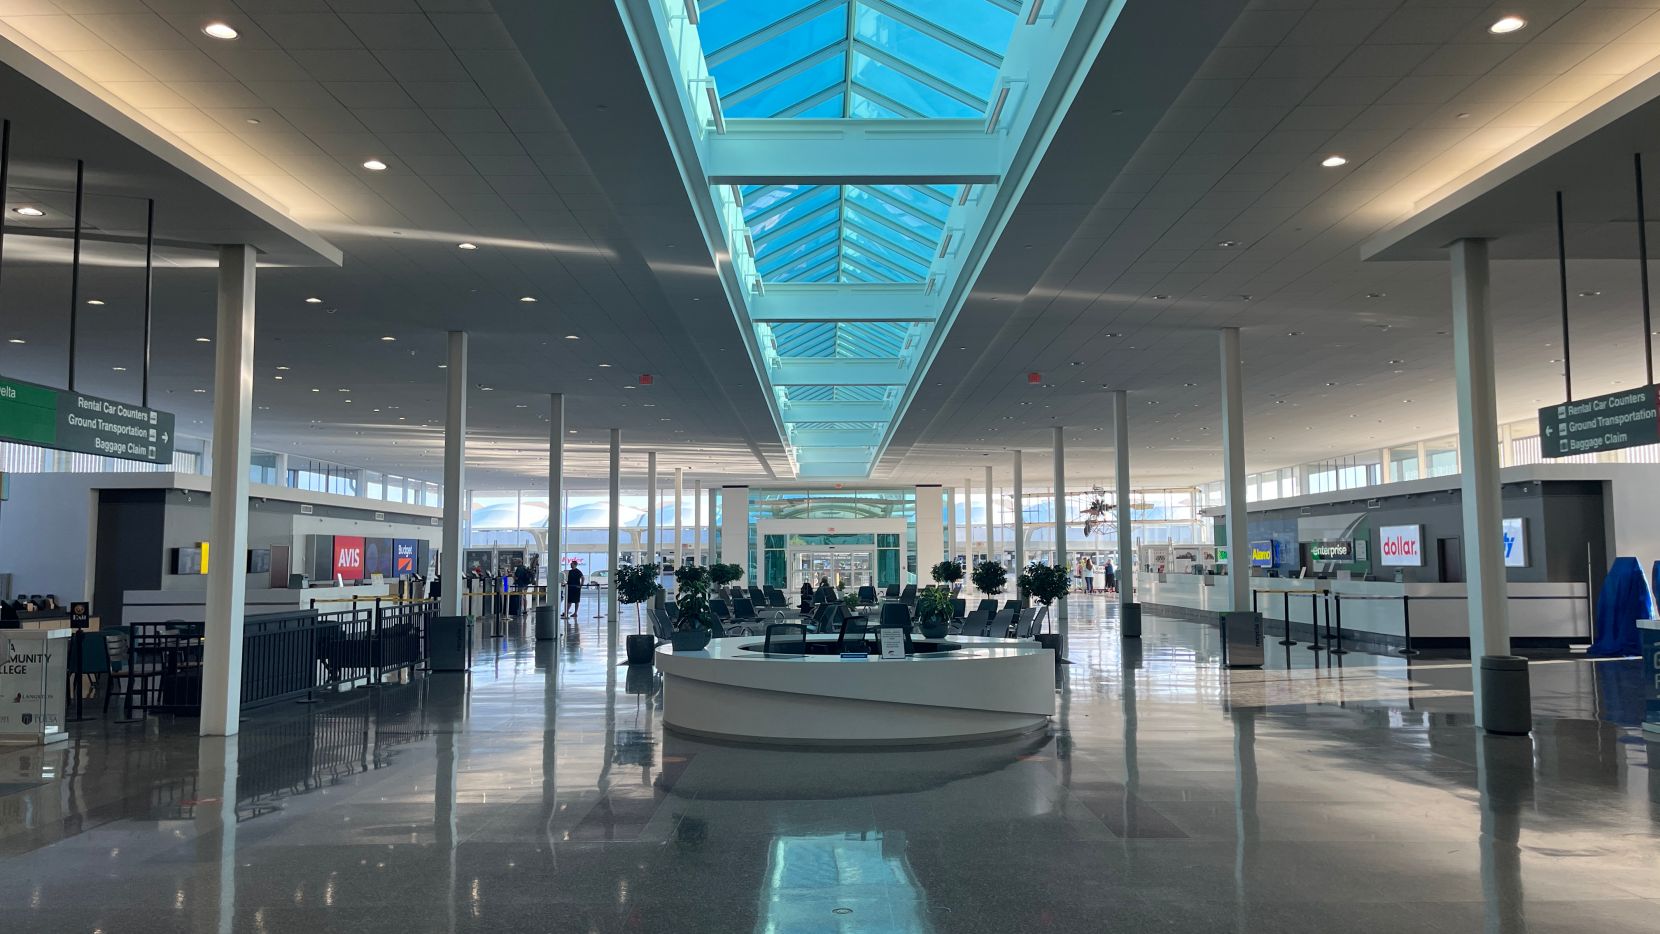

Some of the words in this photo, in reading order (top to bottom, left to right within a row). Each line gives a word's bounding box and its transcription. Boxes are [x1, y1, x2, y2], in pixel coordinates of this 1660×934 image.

[0, 385, 16, 399] elta
[78, 396, 102, 412] Rental
[103, 402, 116, 413] Car
[117, 405, 148, 421] Counters
[1568, 402, 1592, 415] Rental
[1593, 400, 1607, 410] Car
[1608, 393, 1646, 407] Counters
[68, 414, 97, 429] Ground
[98, 419, 148, 438] Transportation
[1569, 418, 1597, 432] Ground
[1597, 409, 1657, 426] Transportation
[95, 437, 126, 454] Baggage
[127, 442, 147, 455] Claim
[1570, 437, 1603, 451] Baggage
[1604, 432, 1628, 444] Claim
[338, 548, 360, 567] AVIS
[398, 544, 413, 557] Budget
[1252, 548, 1271, 560] Alamo
[1312, 544, 1348, 558] enterprise
[8, 653, 52, 664] MUNITY
[0, 664, 27, 674] LEGE
